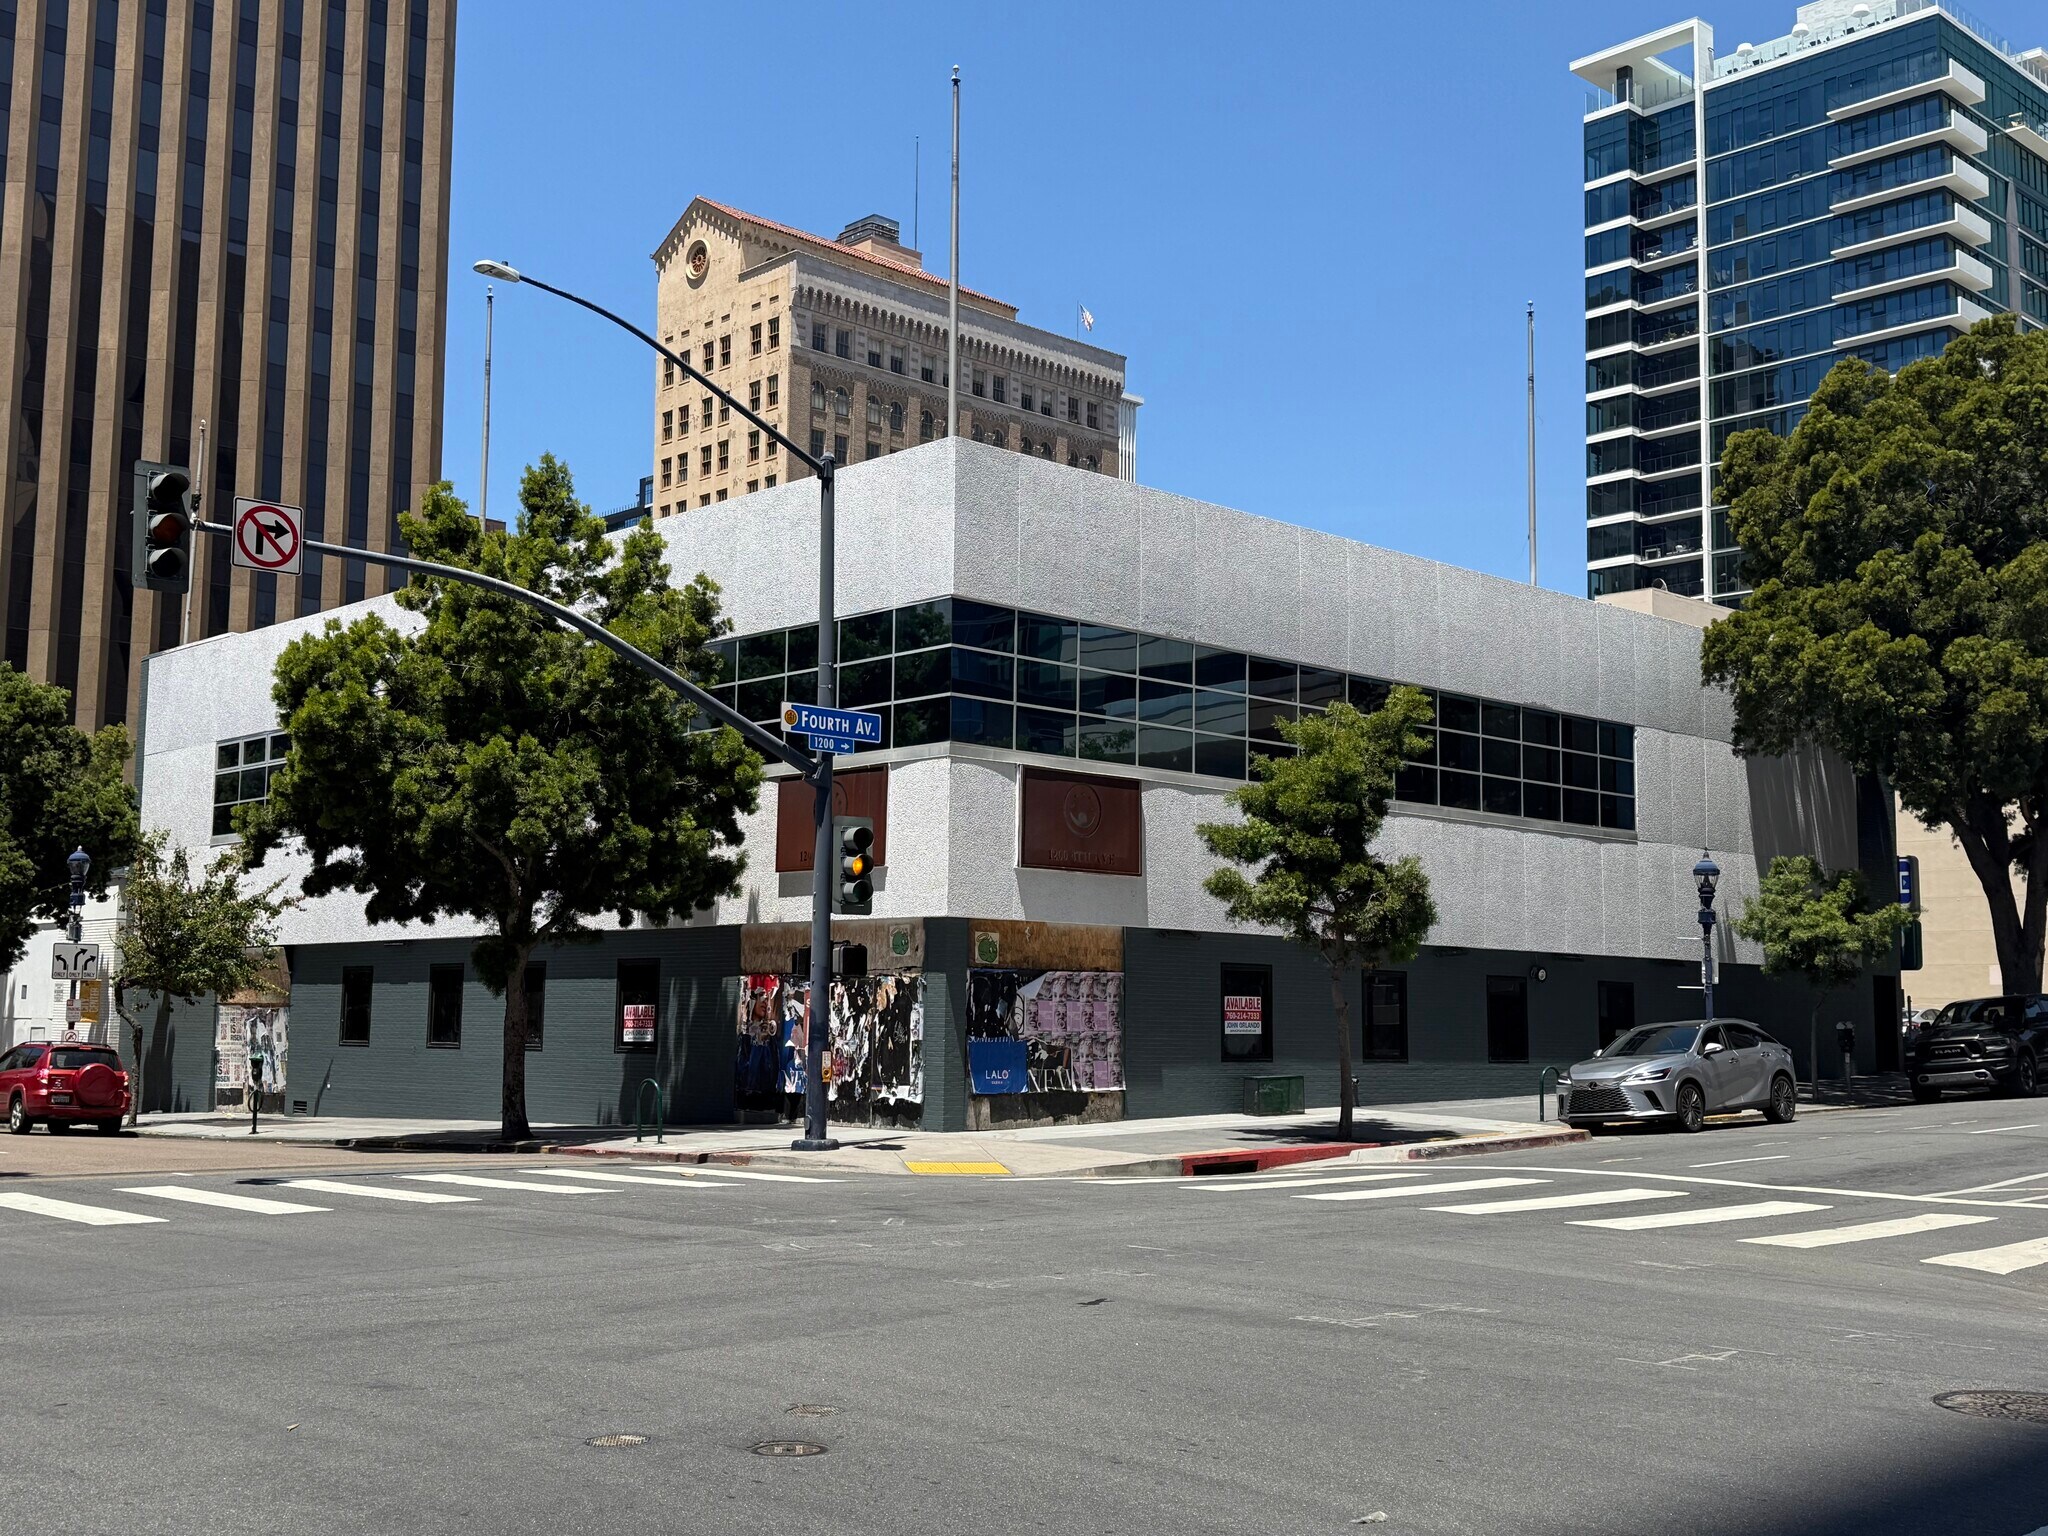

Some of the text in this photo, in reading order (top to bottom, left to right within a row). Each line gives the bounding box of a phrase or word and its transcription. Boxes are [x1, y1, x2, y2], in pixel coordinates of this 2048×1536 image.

[814, 737, 835, 750] 1200
[1226, 997, 1261, 1010] AVAILABLE
[625, 1006, 654, 1018] AVAILABLE
[1226, 1012, 1260, 1020] 760-214-7333
[985, 1069, 1009, 1080] LALO
